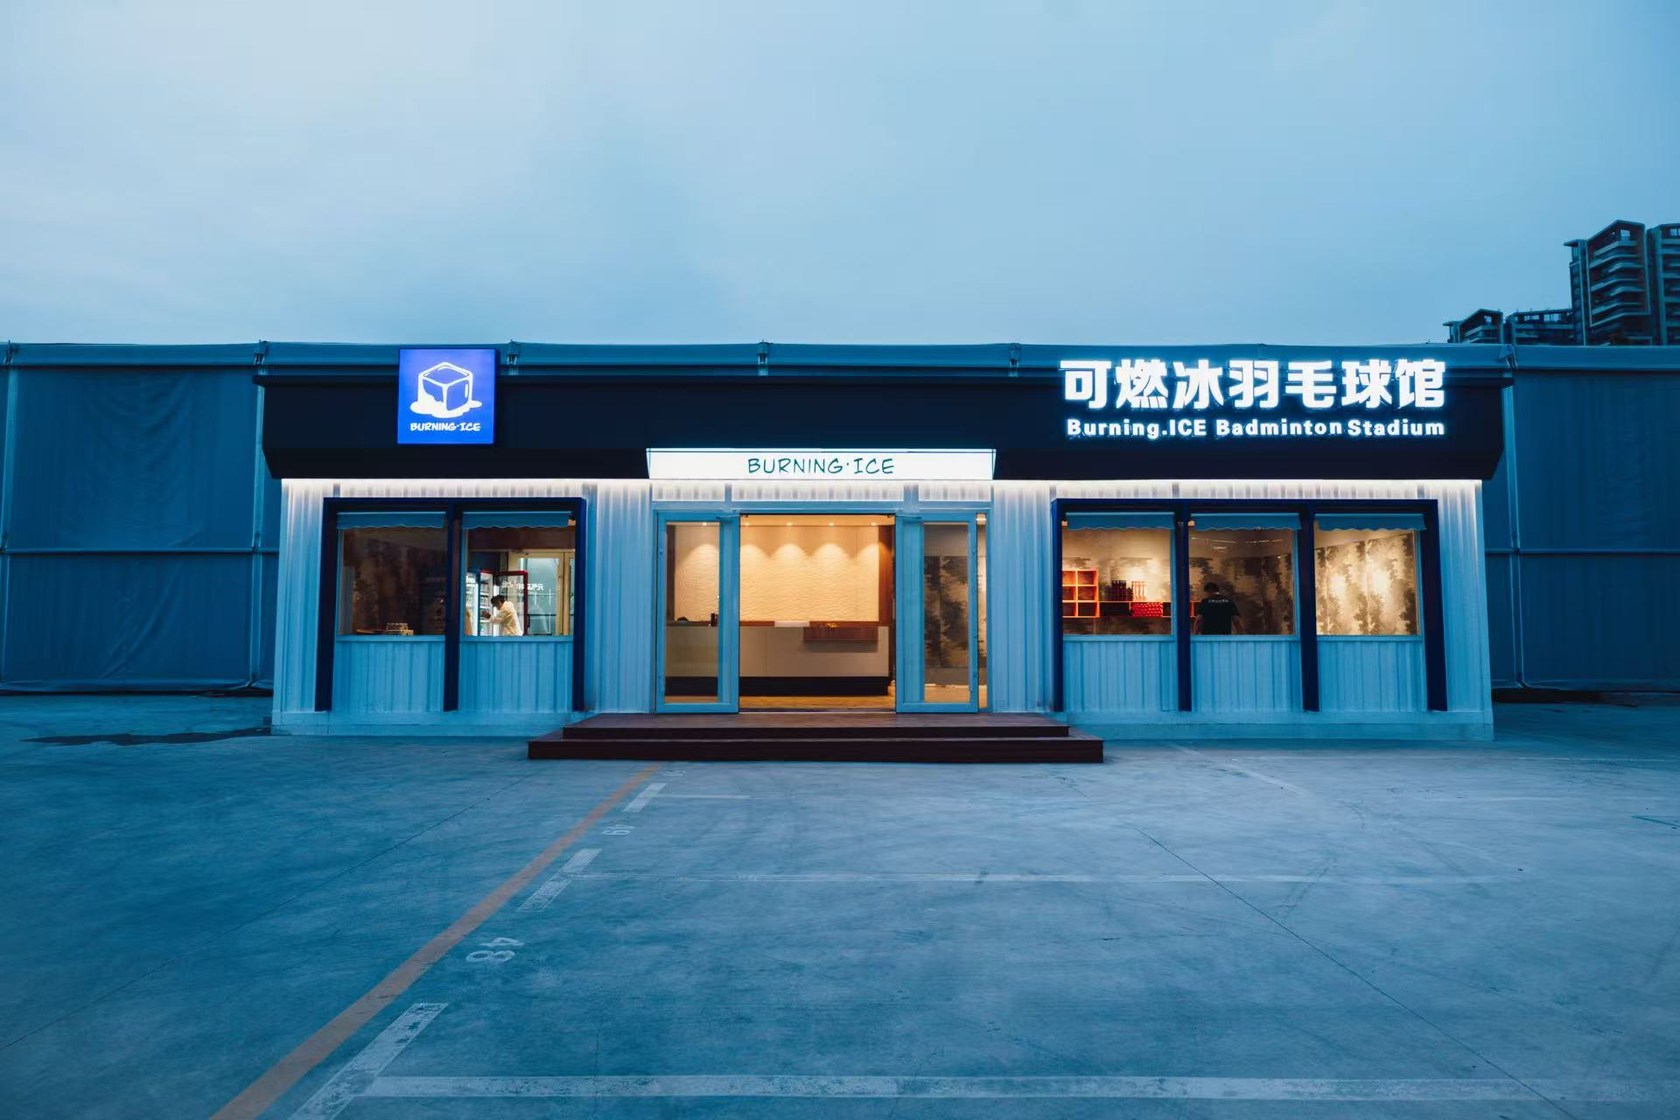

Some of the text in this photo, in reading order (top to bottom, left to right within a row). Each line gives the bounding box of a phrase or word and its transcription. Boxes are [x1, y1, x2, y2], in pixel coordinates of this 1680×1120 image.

[1060, 359, 1446, 409] 可燃冰羽毛球馆
[1216, 418, 1342, 436] Badminton
[1347, 418, 1445, 436] Stadium
